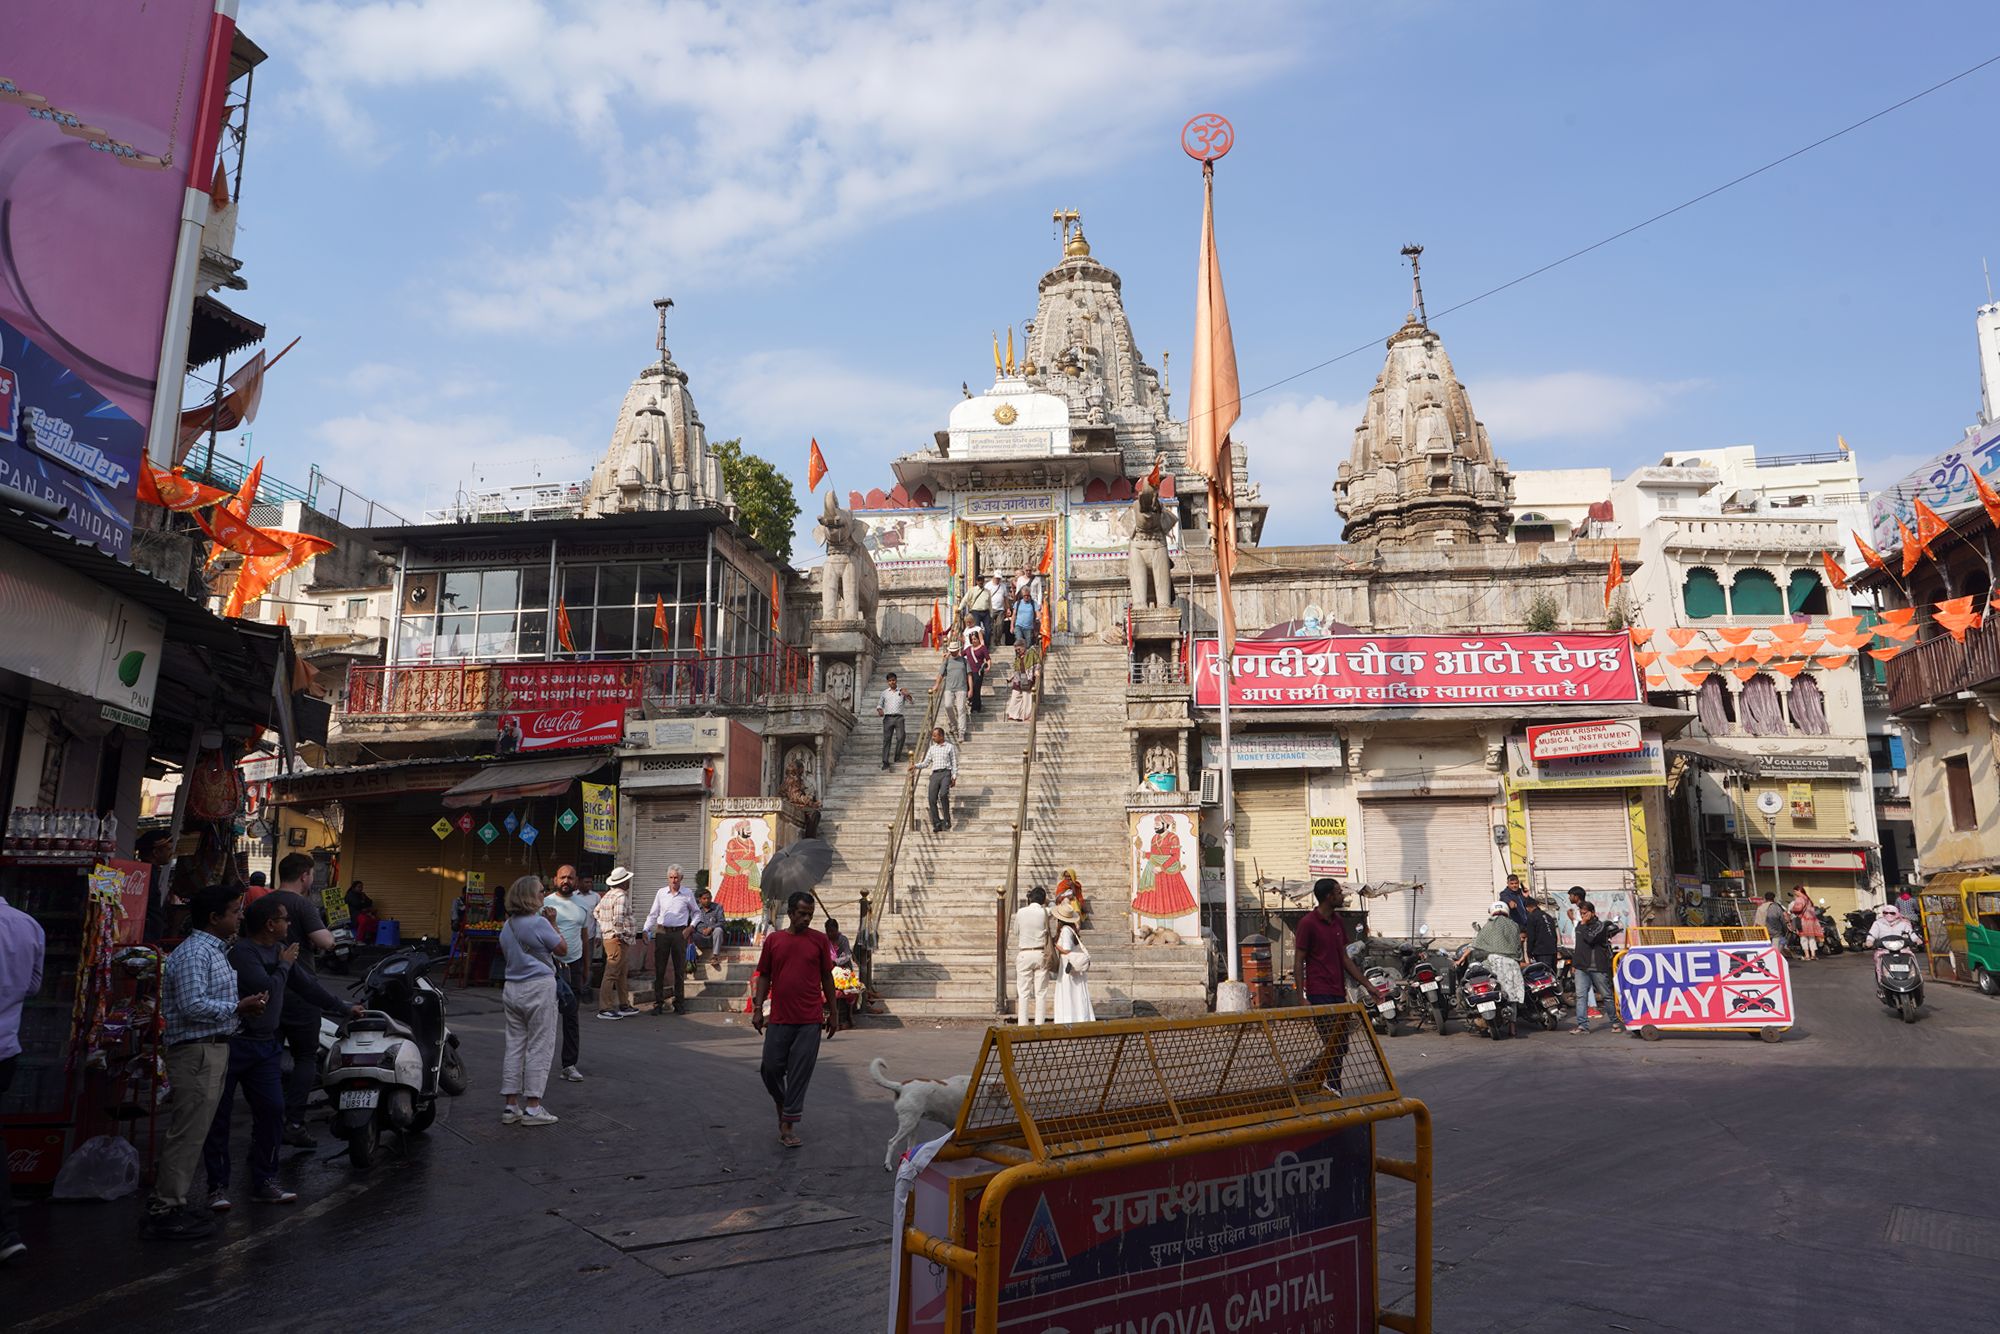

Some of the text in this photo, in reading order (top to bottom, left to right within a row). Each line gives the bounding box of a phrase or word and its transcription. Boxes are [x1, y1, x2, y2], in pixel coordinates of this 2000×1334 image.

[33, 409, 72, 436] Taste
[1346, 642, 1427, 675] चौक
[1435, 641, 1525, 675] ऑटो
[1527, 641, 1621, 674] स्टेण्ड
[130, 691, 149, 708] PAN
[541, 688, 595, 701] Jagdish
[1242, 687, 1284, 701] आप
[1285, 684, 1330, 701] सभी
[1331, 686, 1361, 699] का
[1366, 682, 1430, 699] हार्दिक
[1434, 685, 1500, 699] स्वागत
[1501, 684, 1560, 698] करता
[533, 710, 584, 734] Coca-Cola
[589, 734, 617, 742] KRISHNA
[1538, 731, 1632, 746] MUSICAL INSTRUMENT
[1550, 725, 1607, 737] HARE KRISHNA
[1210, 741, 1257, 753] JADISH
[1238, 752, 1306, 761] MONEY EXCHANGE
[353, 772, 393, 788] ART
[1622, 768, 1662, 776] Instruments
[583, 801, 603, 816] BIKE
[593, 818, 616, 831] RENT
[1311, 818, 1345, 828] MONEY
[1622, 951, 1714, 986] ONE
[1624, 986, 1718, 1020] WAY
[1092, 1151, 1334, 1233] राजस्थान पुलिस
[1149, 1216, 1292, 1266] सुगम एवं सुरक्षित यातायात
[1225, 1269, 1334, 1332] CAPITAL
